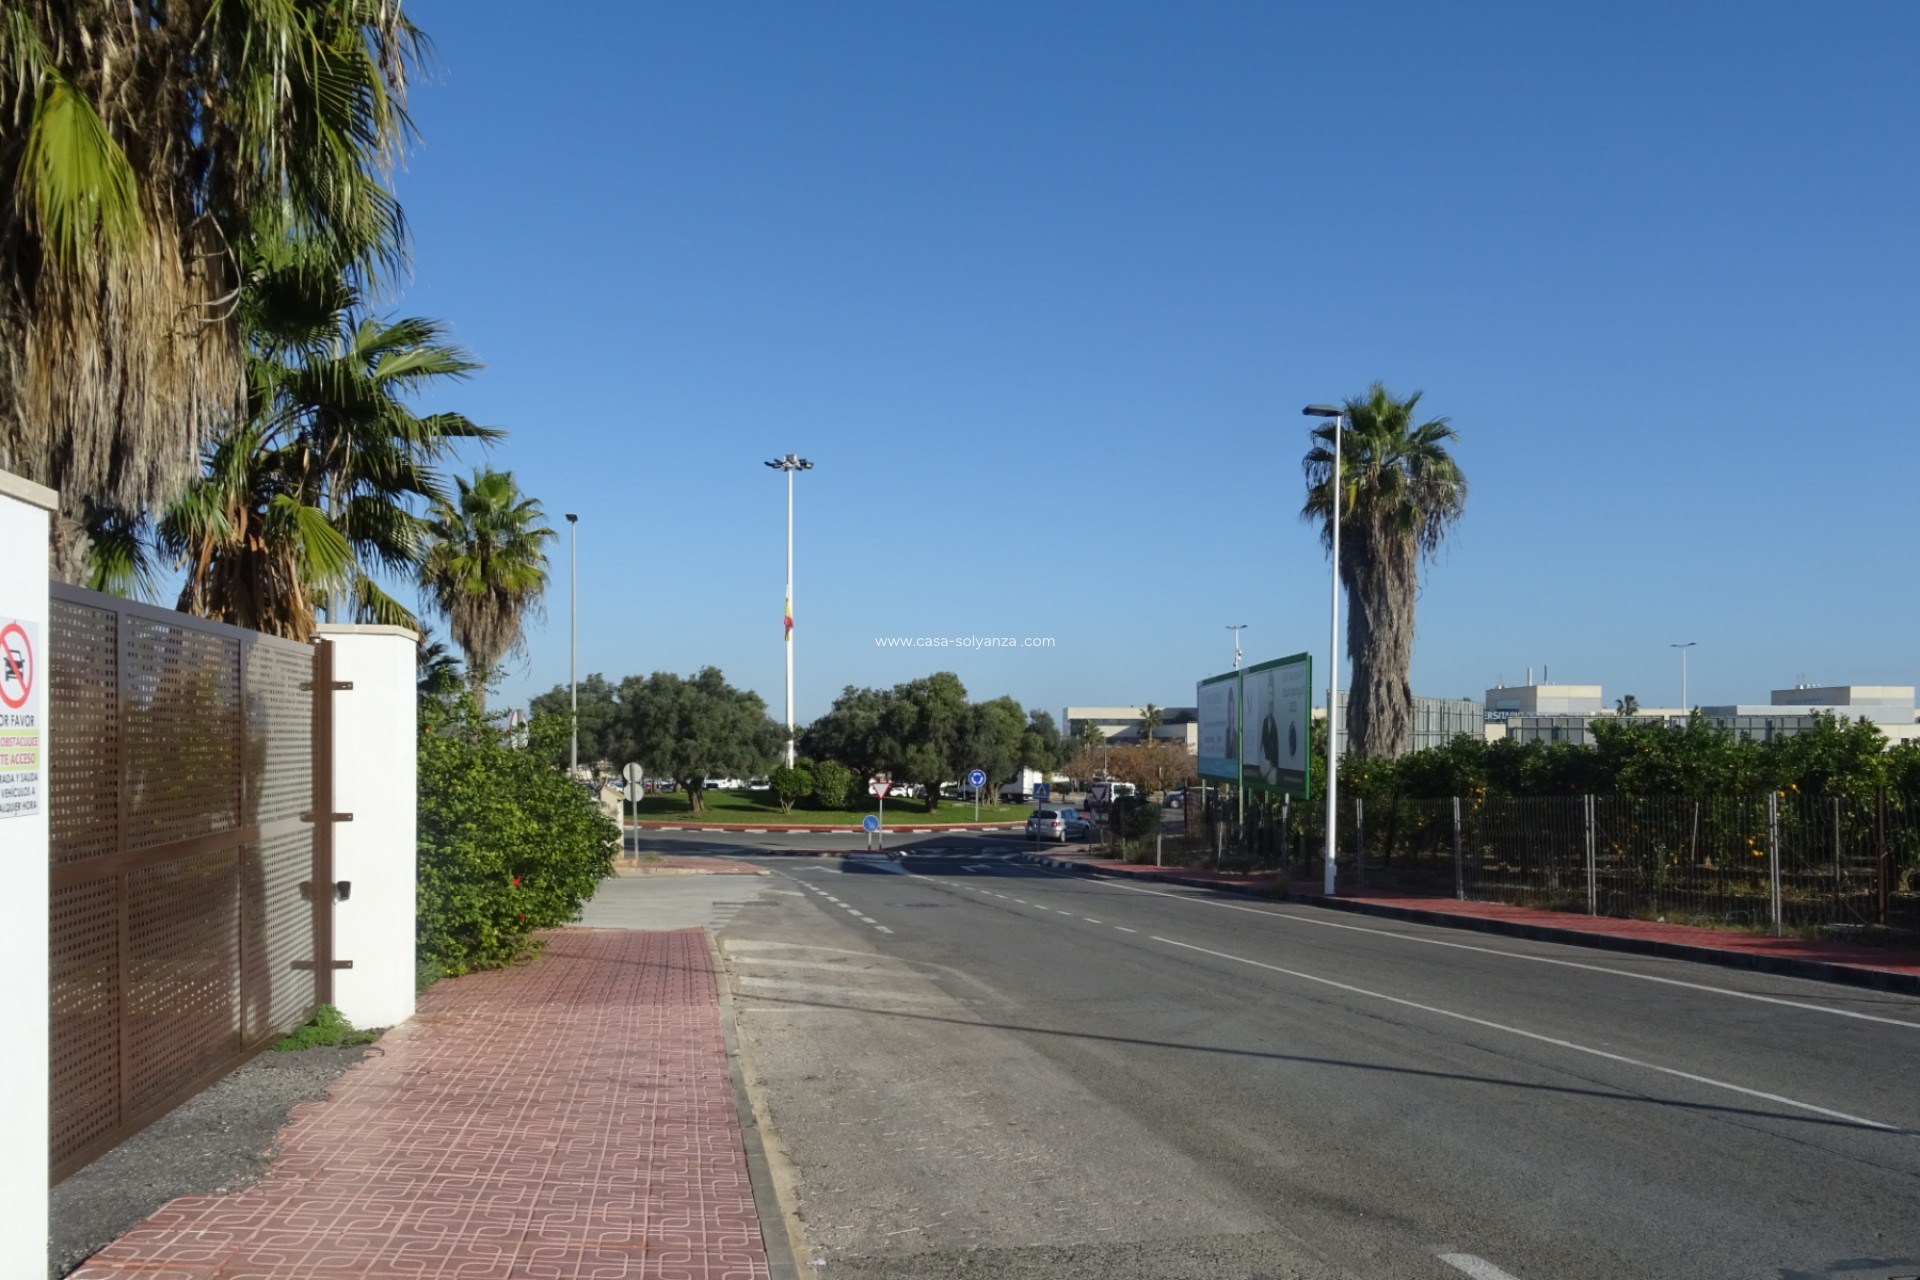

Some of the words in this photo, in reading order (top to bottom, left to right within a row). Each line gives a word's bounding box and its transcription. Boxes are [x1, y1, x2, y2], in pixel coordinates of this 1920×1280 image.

[11, 714, 35, 727] FAVOR
[11, 753, 35, 765] ACCESO
[21, 773, 38, 782] SALIDA
[22, 801, 37, 810] HORA
